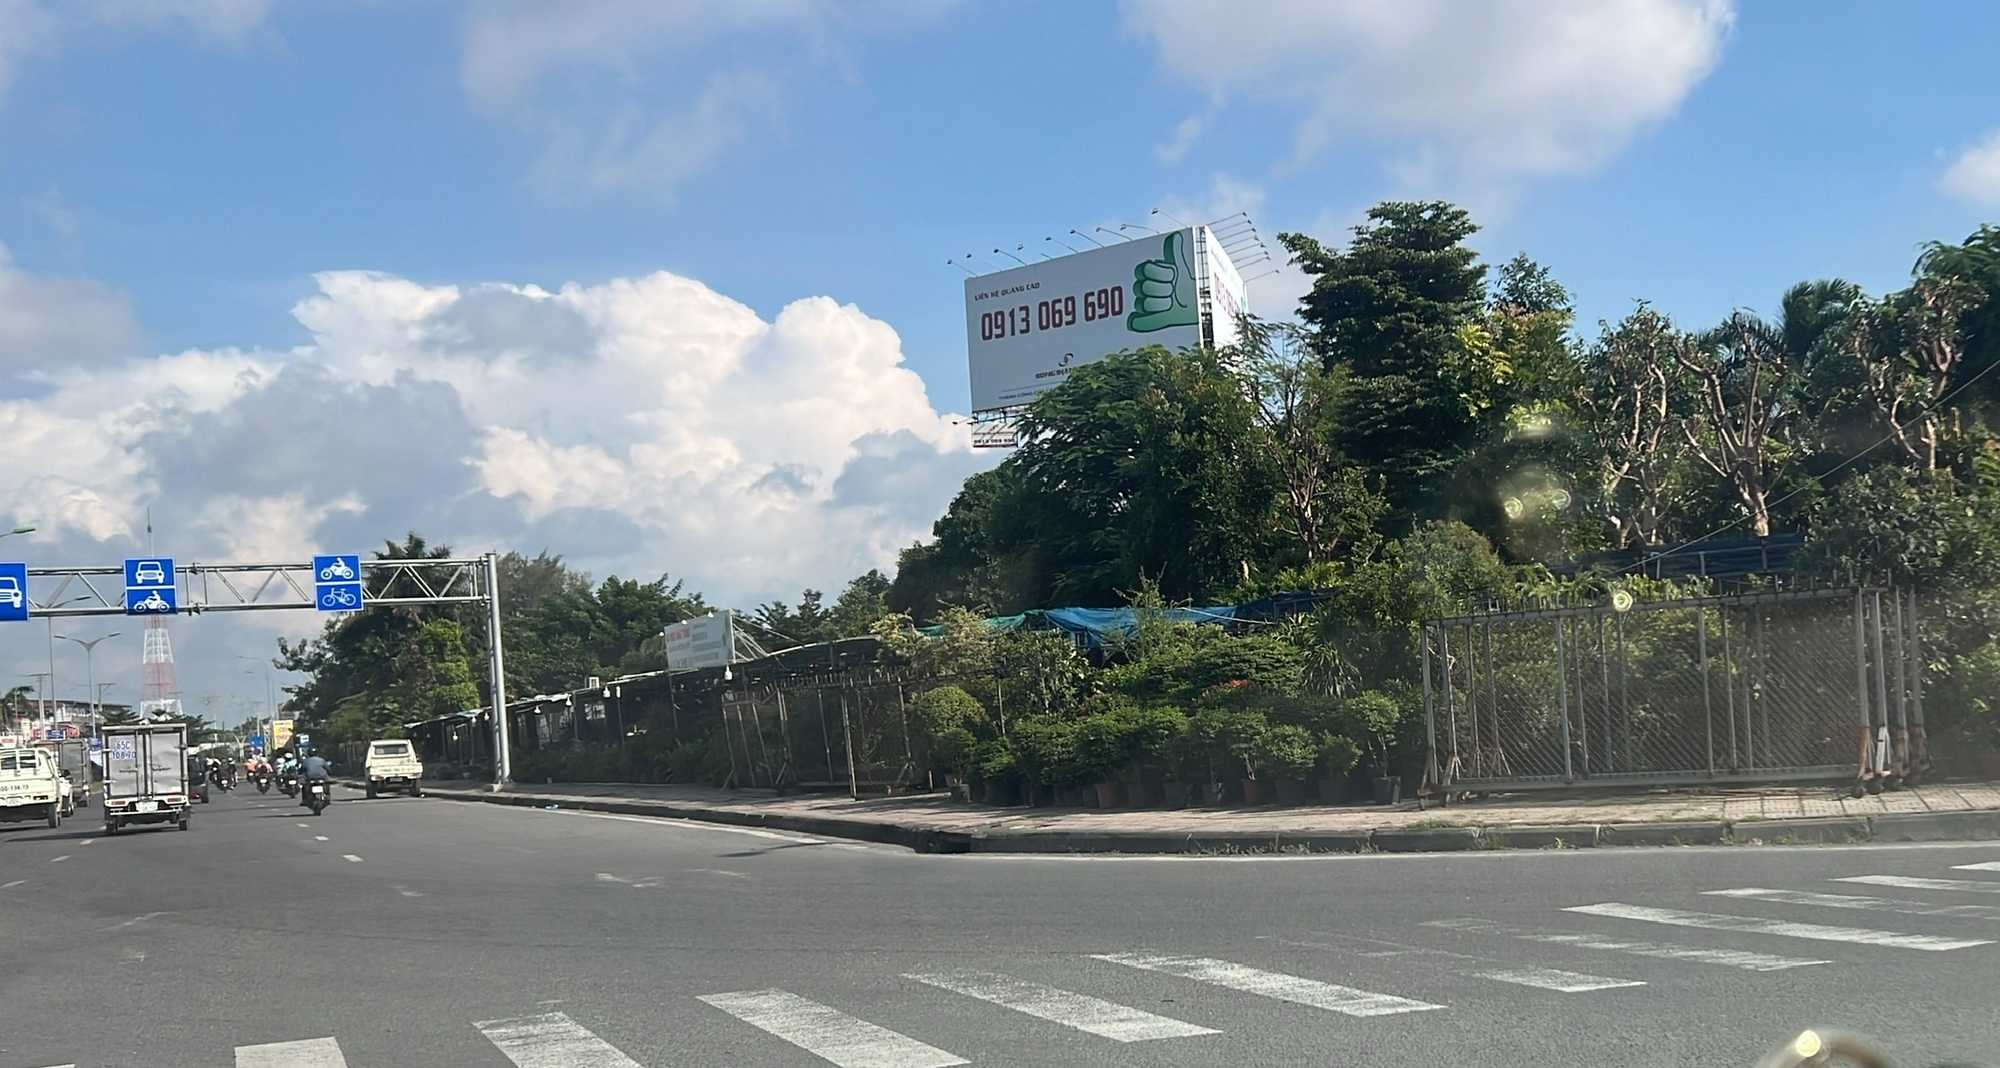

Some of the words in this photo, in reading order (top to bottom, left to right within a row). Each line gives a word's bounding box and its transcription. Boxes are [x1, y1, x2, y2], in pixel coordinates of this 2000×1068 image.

[981, 304, 1030, 340] 0913
[1038, 295, 1076, 331] 069
[1084, 285, 1123, 322] 690
[117, 741, 131, 750] 65C
